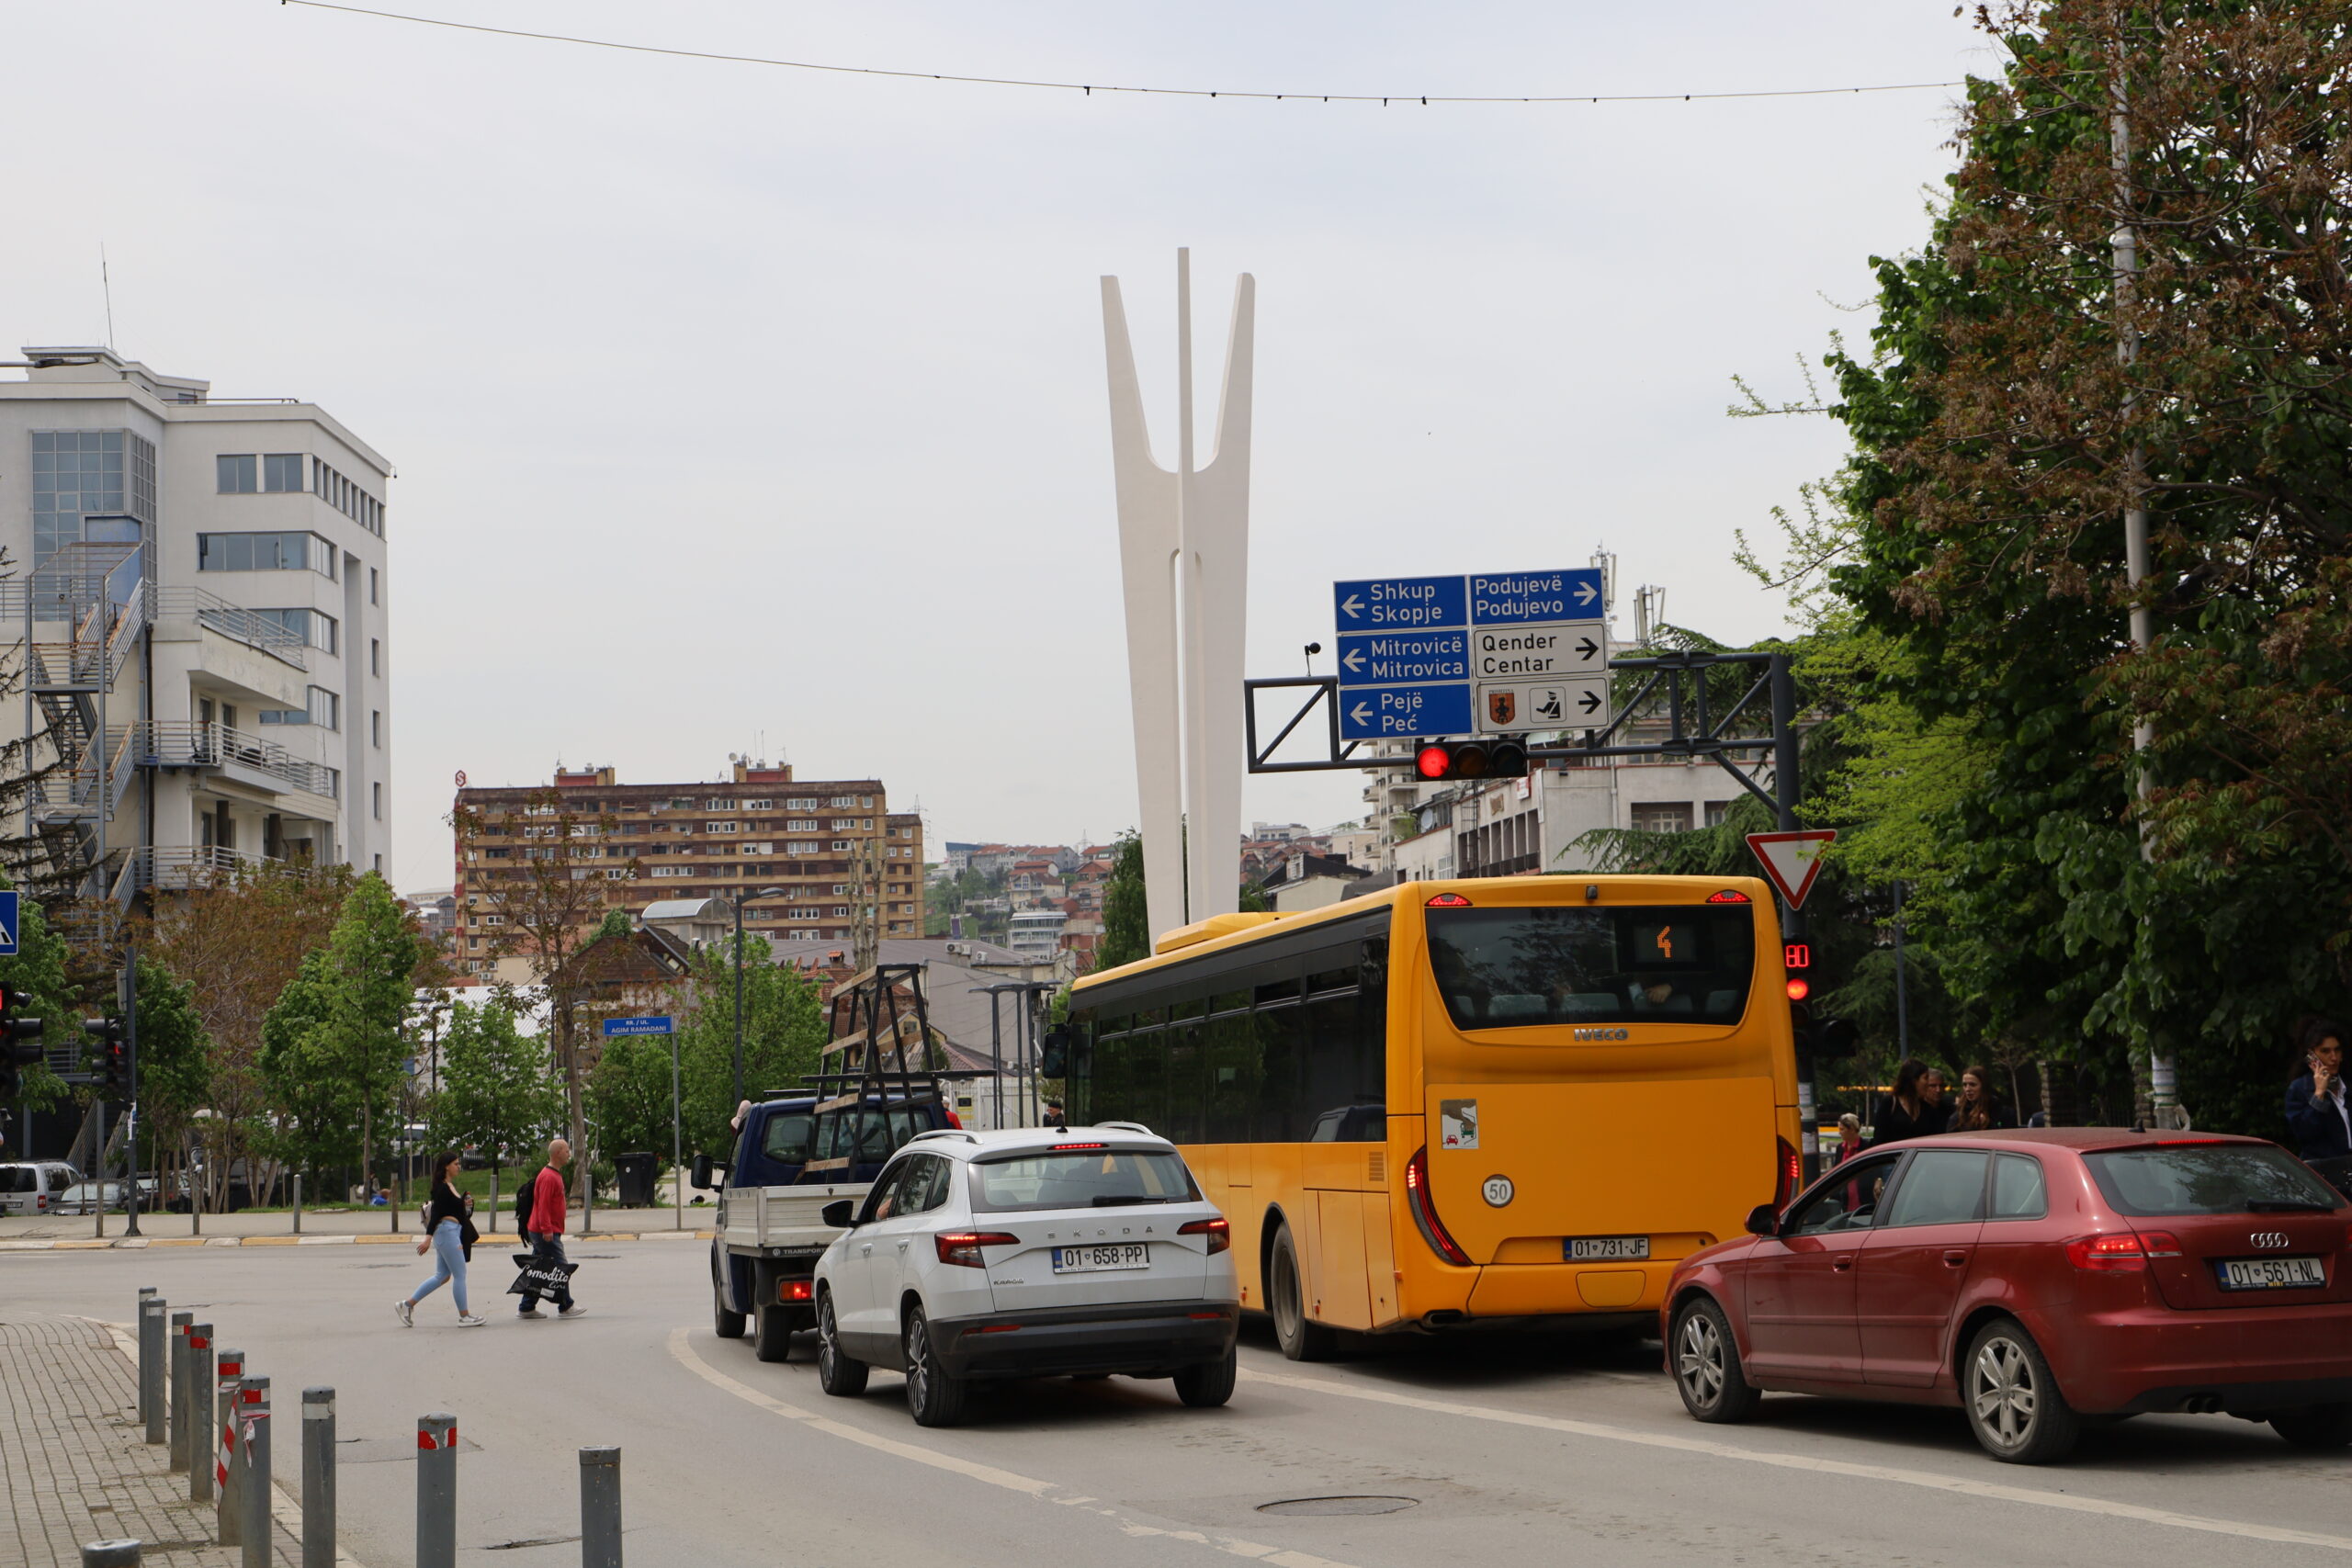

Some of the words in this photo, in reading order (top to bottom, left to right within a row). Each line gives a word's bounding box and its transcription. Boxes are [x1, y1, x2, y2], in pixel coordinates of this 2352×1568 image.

[1370, 582, 1435, 603] Shkup
[1476, 574, 1562, 597] Podujevë
[1371, 603, 1442, 625] Skopje
[1476, 597, 1563, 619] Podujevo
[1371, 636, 1463, 657] Mitrovicë
[1482, 633, 1557, 651] Qender
[1372, 659, 1464, 679] Mitrovica
[1483, 656, 1555, 673] Centar
[1381, 692, 1423, 714] Pejë
[1382, 713, 1418, 733] Peć
[1657, 925, 1672, 958] 4
[1785, 944, 1808, 967] 80
[1574, 1028, 1629, 1042] IVECO
[1489, 1183, 1508, 1200] 50
[1065, 1249, 1082, 1266] 01
[1575, 1241, 1590, 1257] 01
[2231, 1263, 2252, 1286] 01
